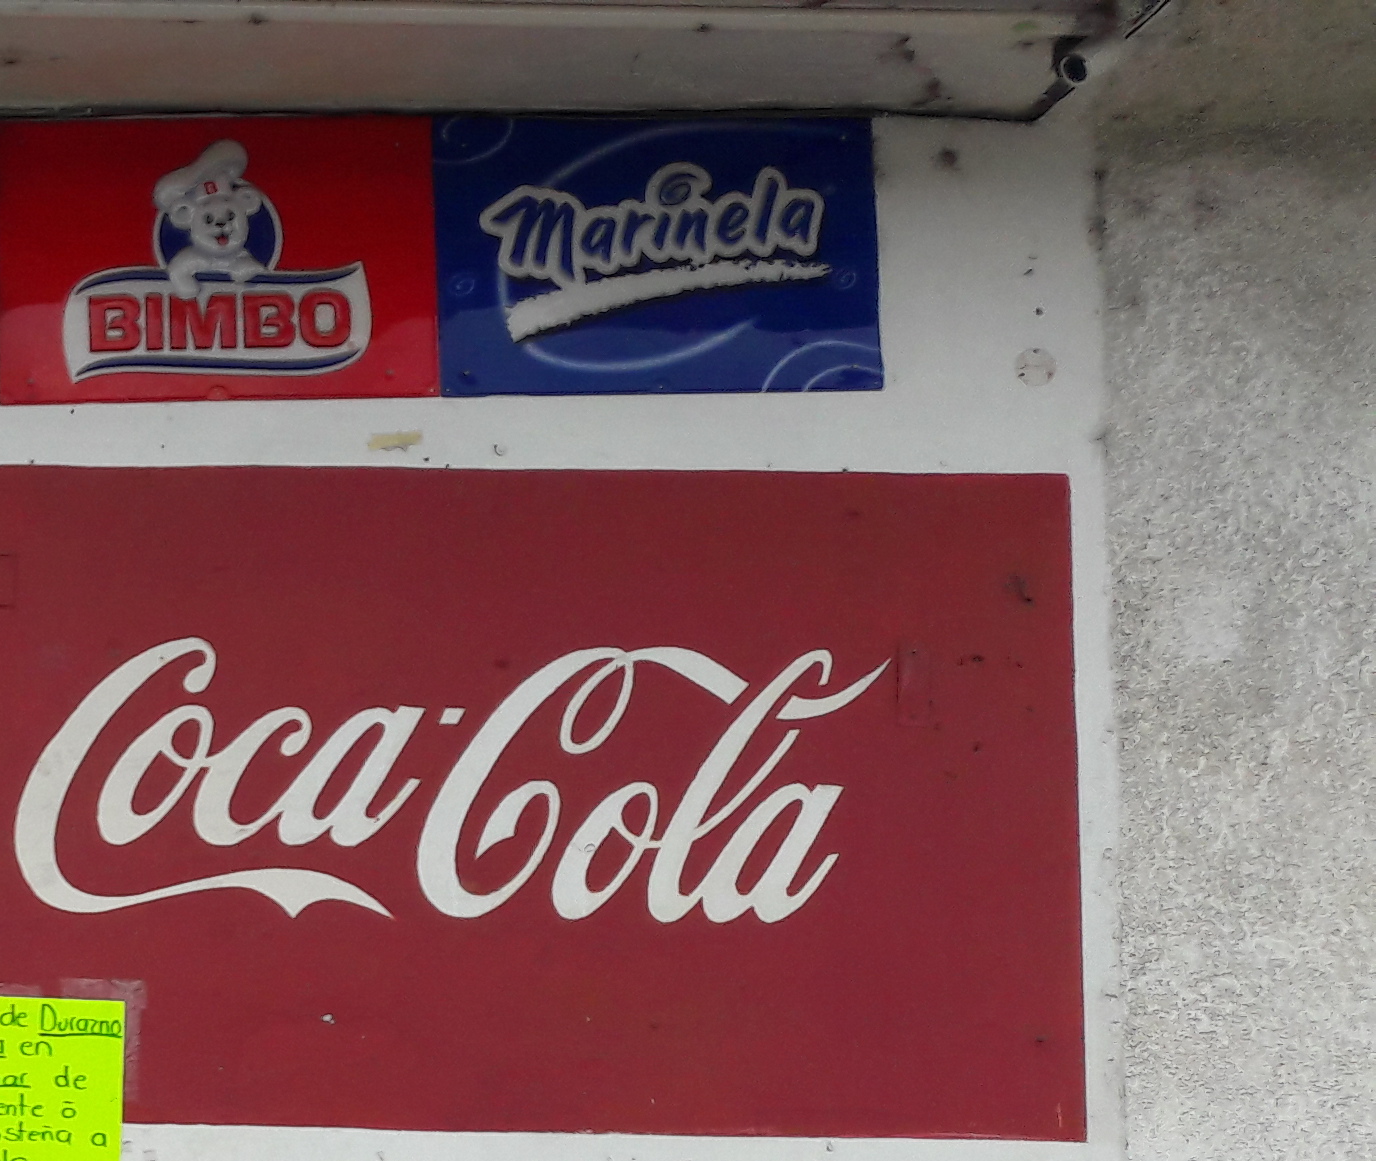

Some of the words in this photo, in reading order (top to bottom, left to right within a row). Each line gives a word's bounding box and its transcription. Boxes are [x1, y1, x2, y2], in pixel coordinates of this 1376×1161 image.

[484, 162, 823, 287] Marinela
[87, 291, 354, 354] BIMBO
[0, 1003, 29, 1028] de
[40, 1003, 123, 1036] Durazno
[19, 1039, 53, 1057] en
[54, 1065, 88, 1090] de
[90, 1132, 108, 1148] a
